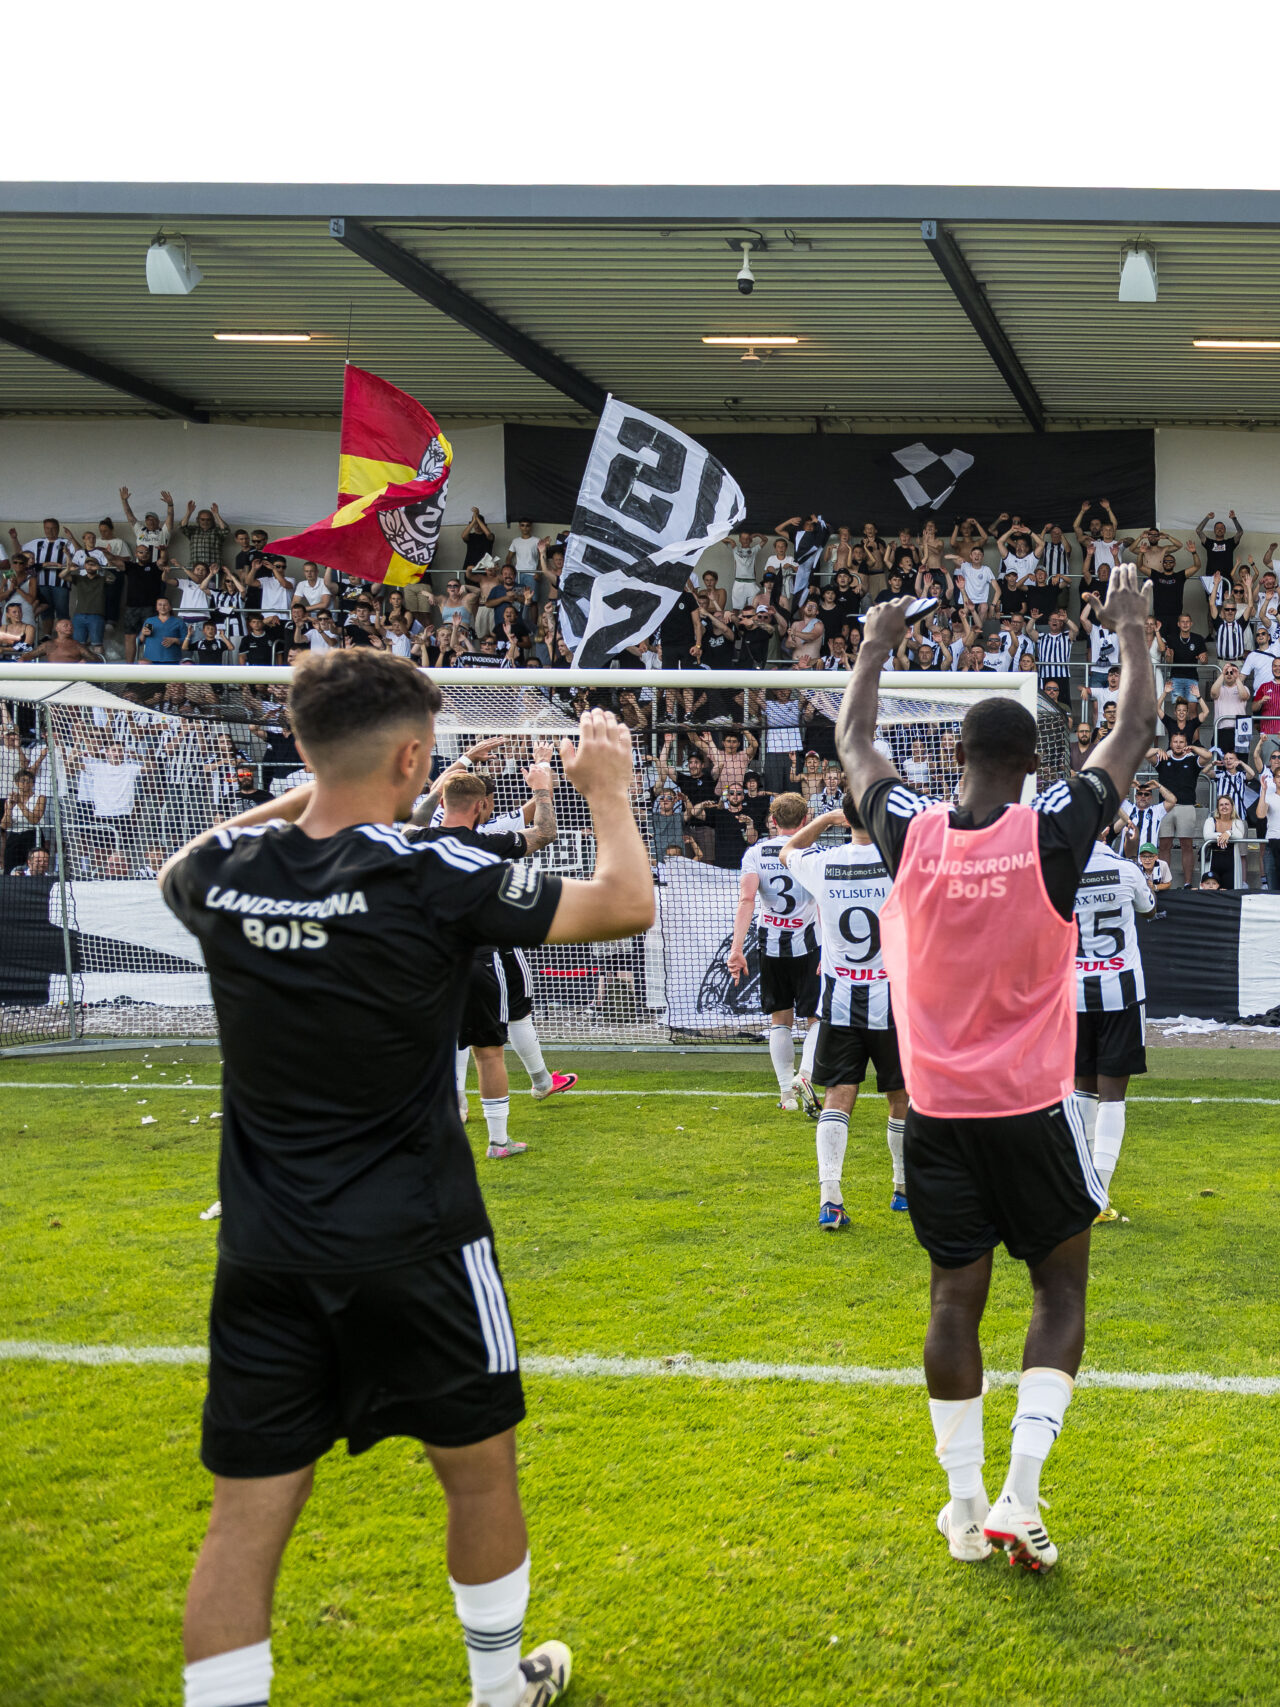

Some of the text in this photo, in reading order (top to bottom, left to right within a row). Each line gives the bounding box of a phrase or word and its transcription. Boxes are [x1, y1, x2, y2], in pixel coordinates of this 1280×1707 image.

[841, 867, 887, 877] Automotive
[918, 851, 1036, 875] LANDSKRONA
[945, 876, 1007, 899] BoIS
[1081, 874, 1120, 885] tomotive
[205, 886, 368, 919] LANDSKRONA
[769, 874, 796, 916] 3
[829, 887, 885, 899] SYLISUFAJ
[763, 914, 804, 928] PULS
[242, 919, 328, 950] BoIS
[839, 906, 882, 964] 9
